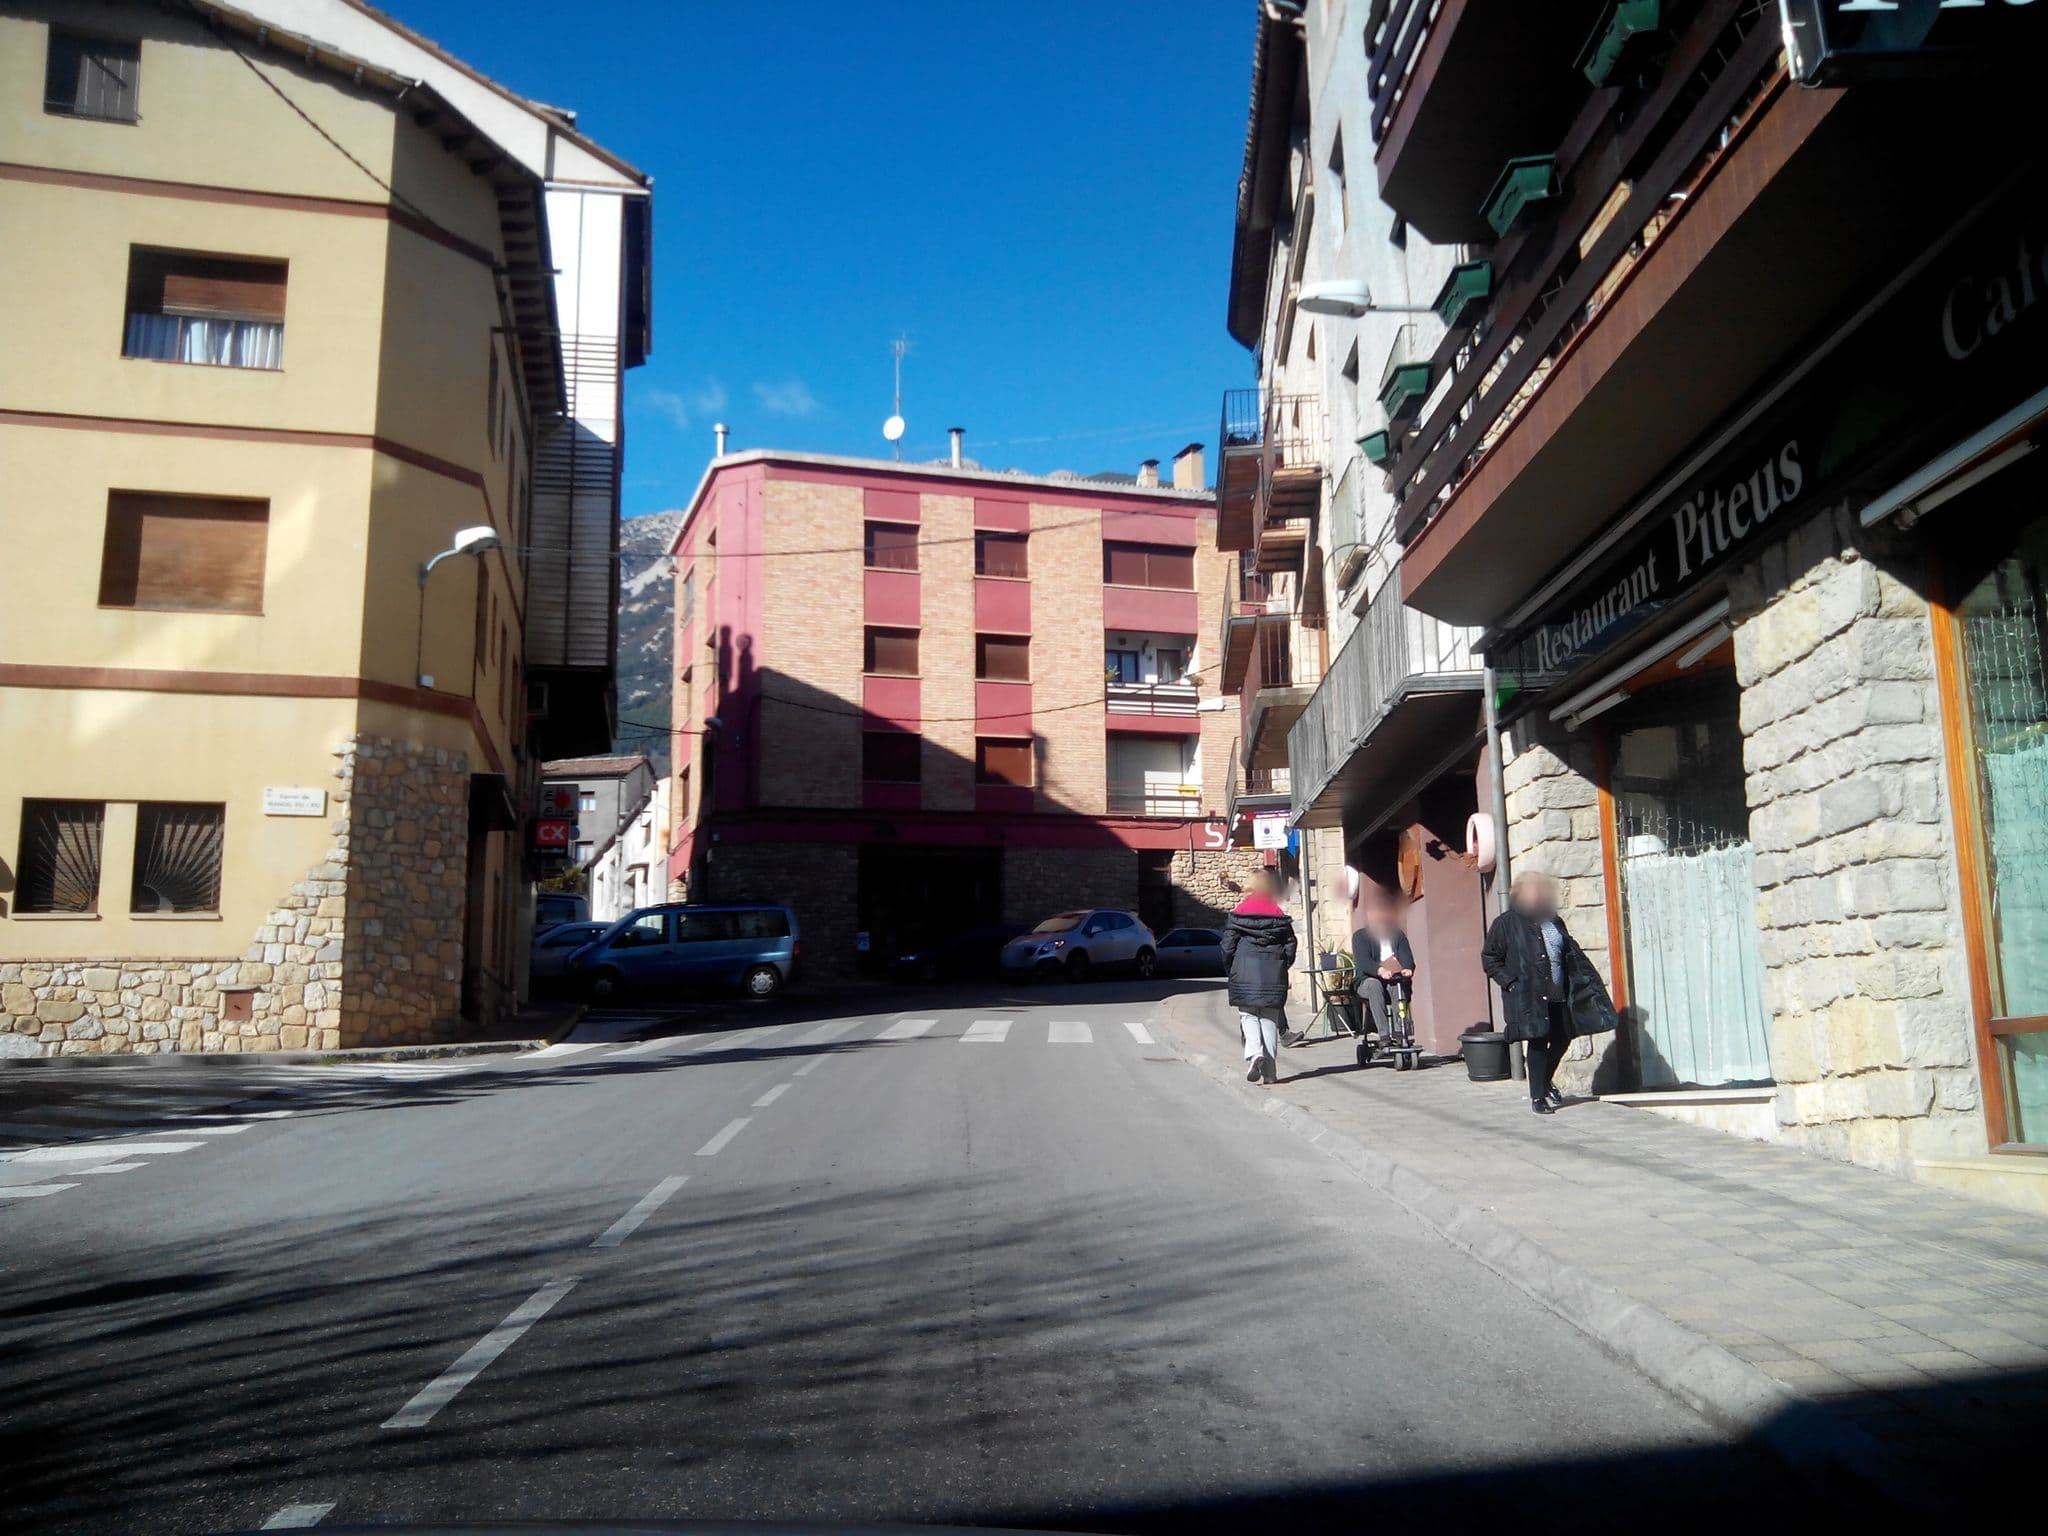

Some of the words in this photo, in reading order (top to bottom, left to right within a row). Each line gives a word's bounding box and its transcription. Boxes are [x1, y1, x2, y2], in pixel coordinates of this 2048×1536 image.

[1942, 222, 2048, 360] Caf
[1536, 549, 1659, 676] Restaurant
[1672, 439, 1803, 583] Piteus
[540, 825, 565, 841] CX
